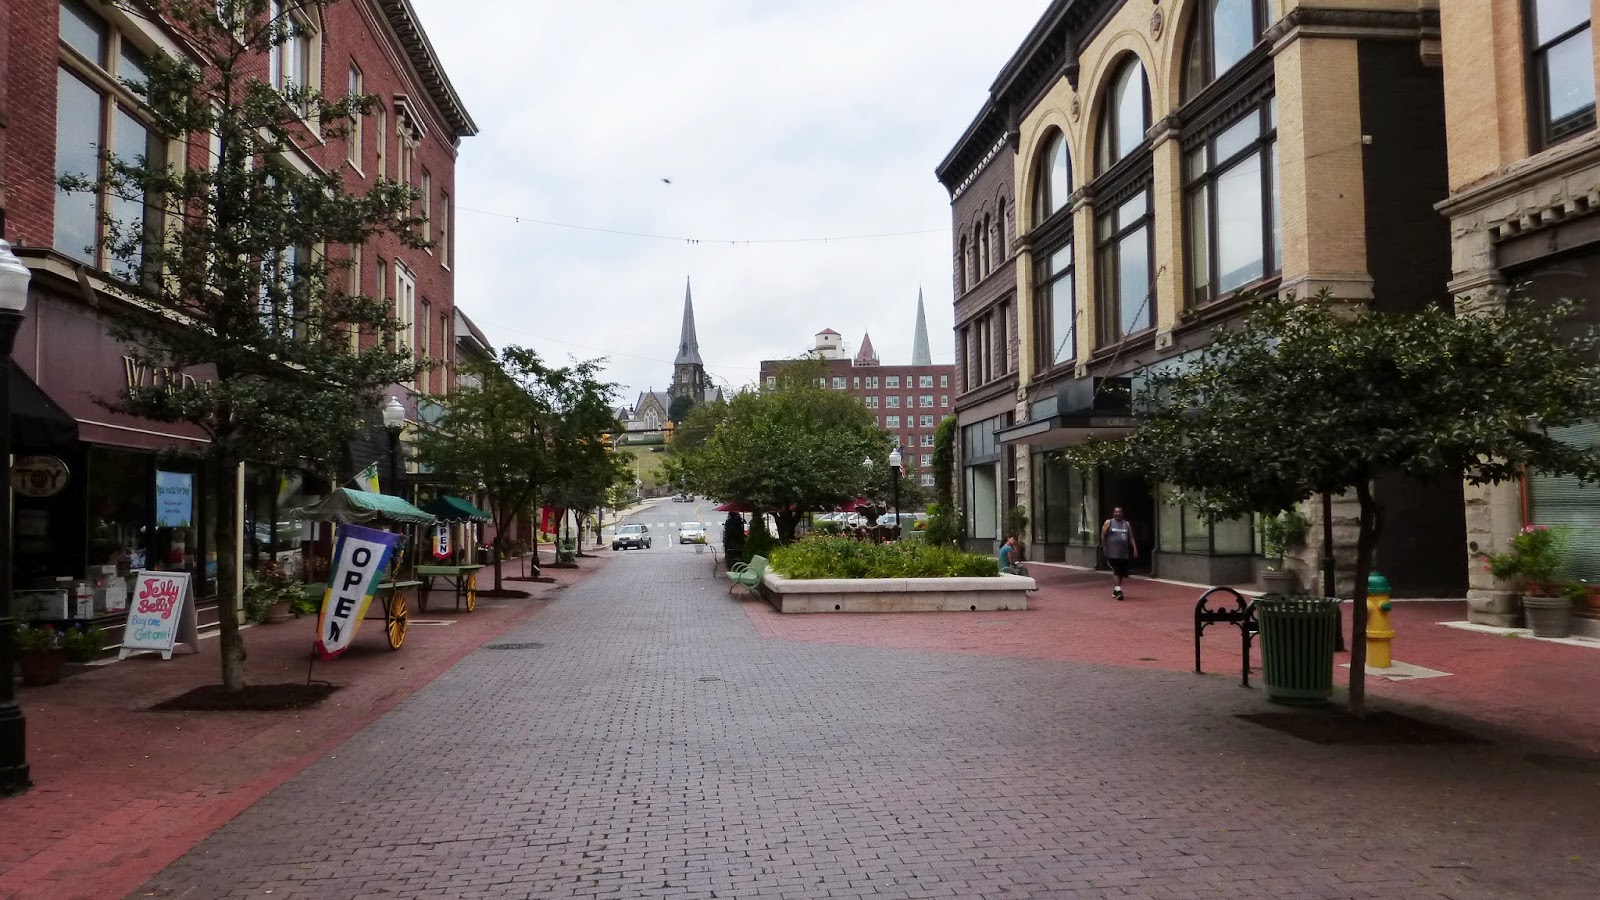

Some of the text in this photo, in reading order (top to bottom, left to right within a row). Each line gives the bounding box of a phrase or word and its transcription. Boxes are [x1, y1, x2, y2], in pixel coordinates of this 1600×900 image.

[15, 468, 61, 489] TOY
[139, 578, 180, 605] Jelly
[327, 547, 372, 642] OPEN
[137, 597, 173, 620] Belly
[132, 614, 147, 628] Buy
